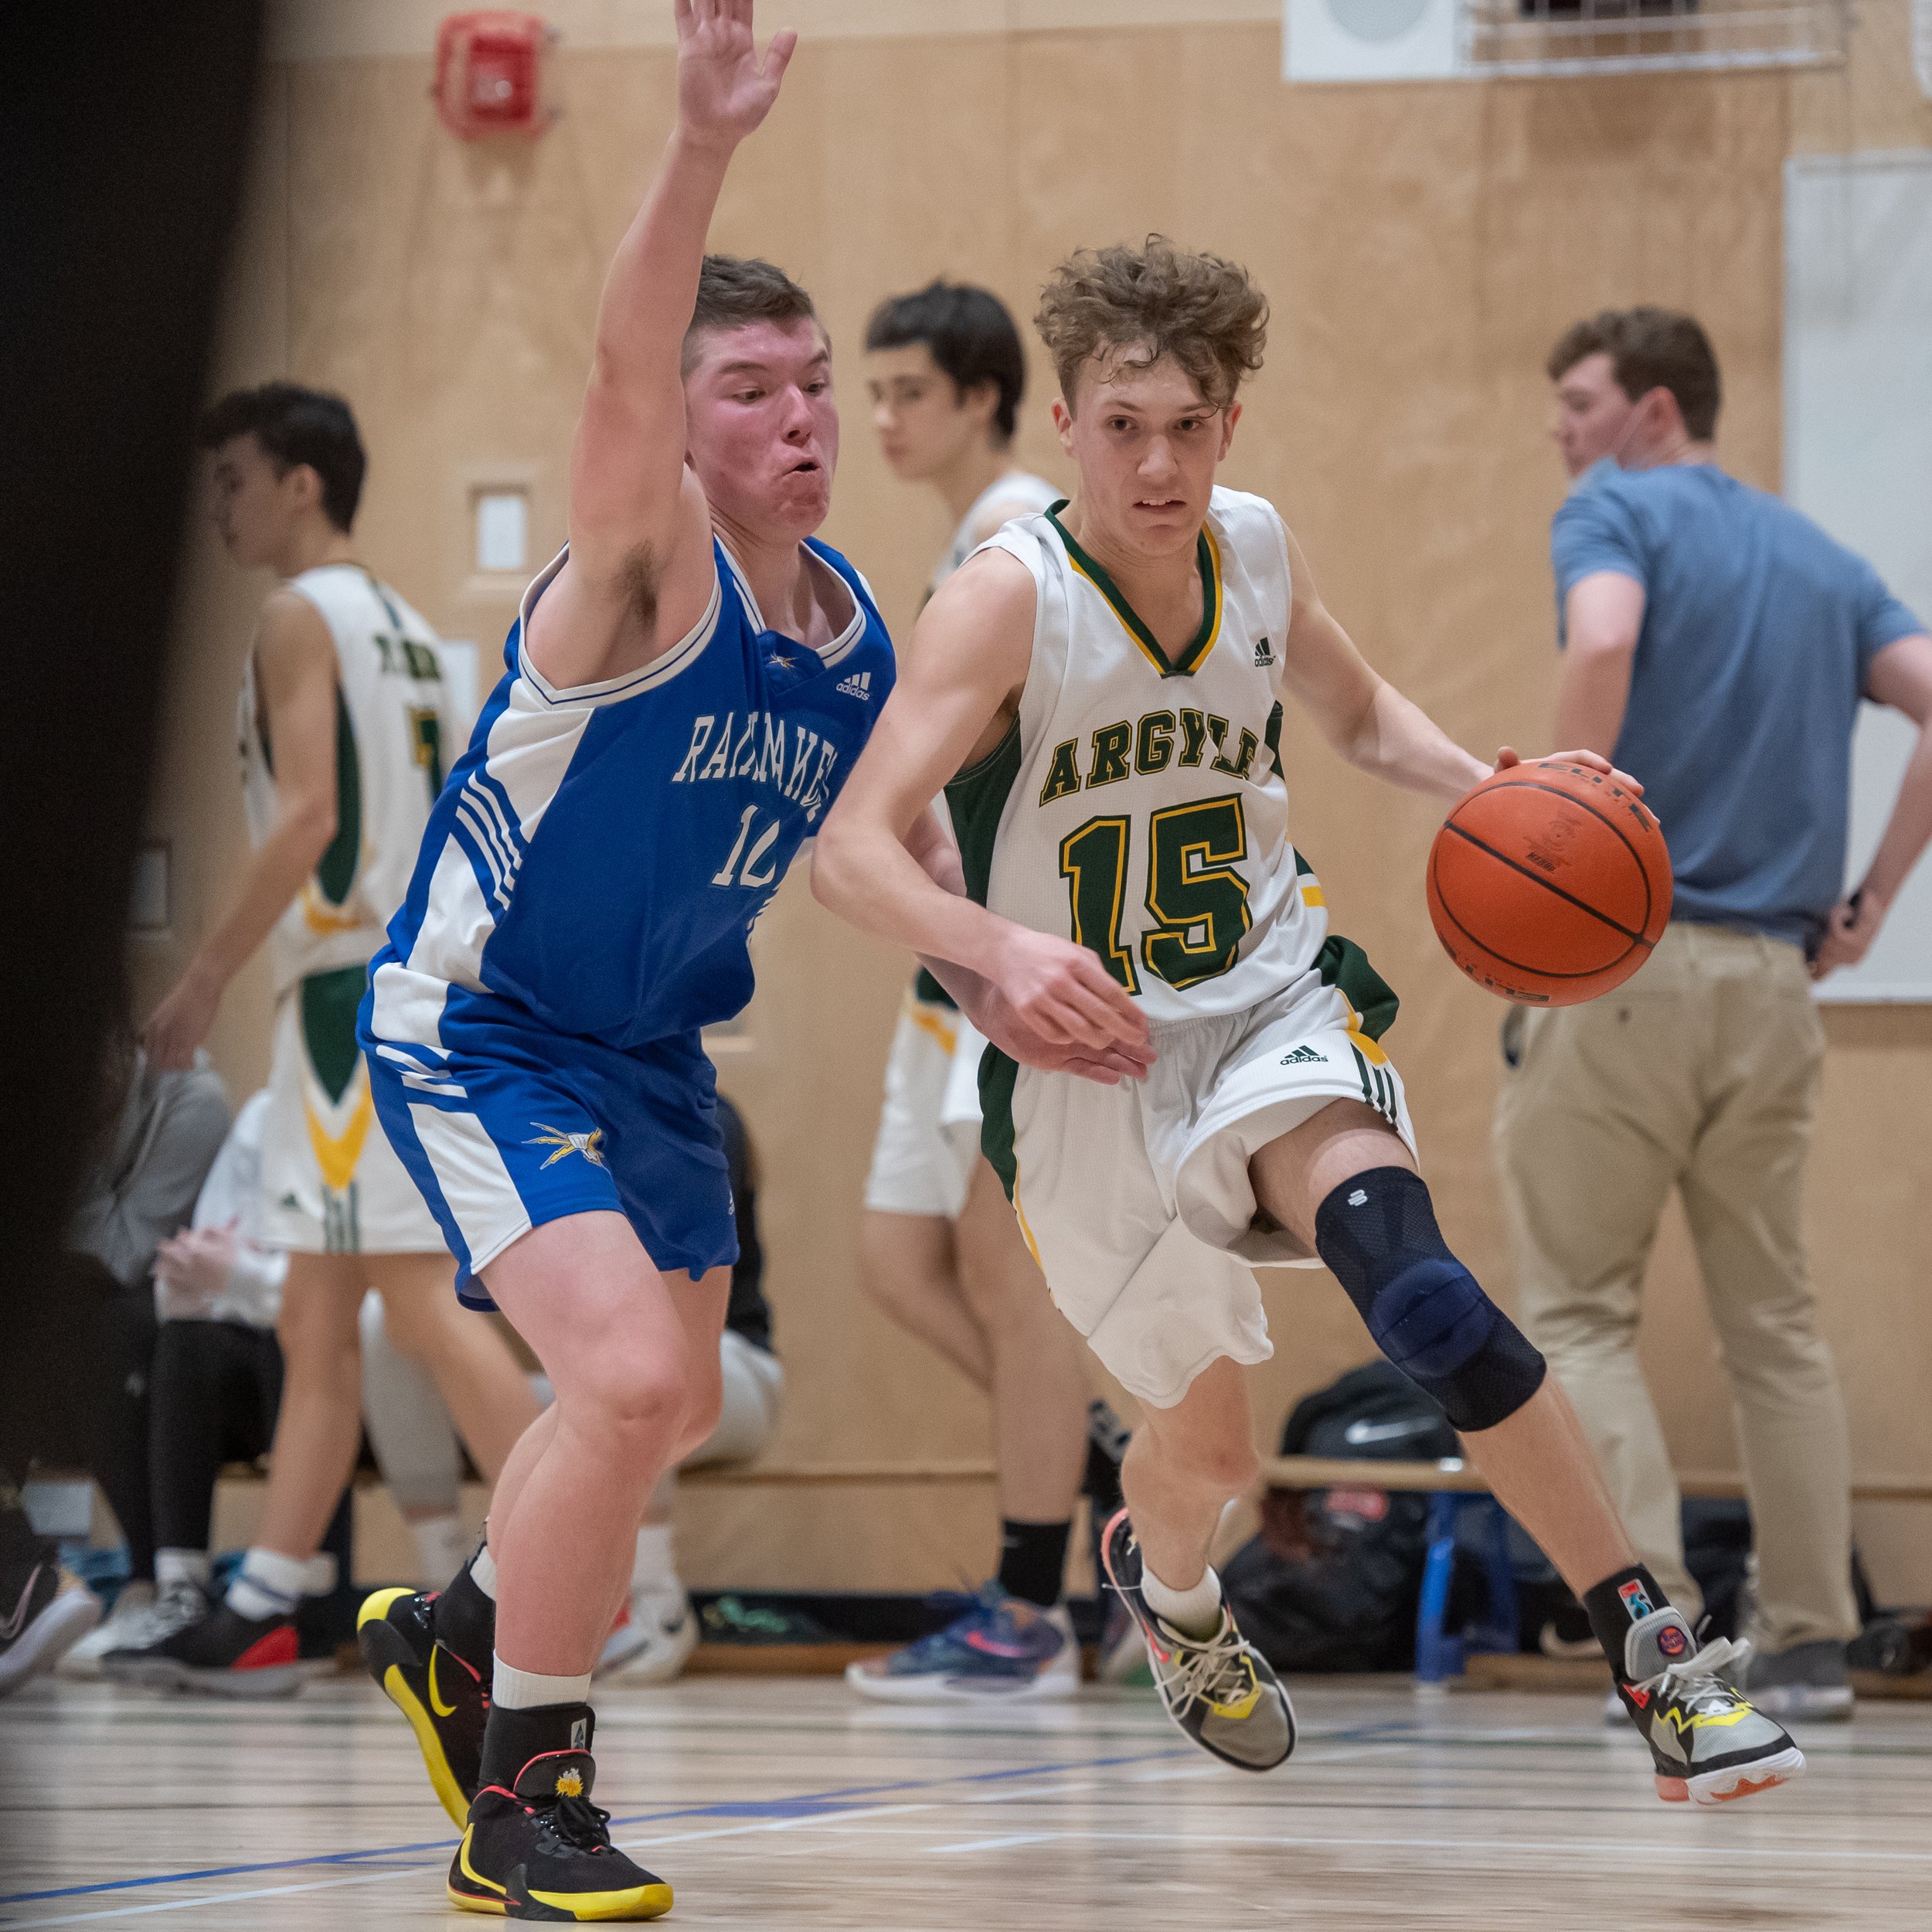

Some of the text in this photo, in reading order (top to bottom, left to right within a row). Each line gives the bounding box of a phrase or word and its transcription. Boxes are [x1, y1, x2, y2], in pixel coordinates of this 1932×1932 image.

[836, 683, 870, 701] adidas
[1039, 708, 1260, 808] ARGYLE
[1059, 792, 1253, 996] 15
[1280, 1055, 1328, 1066] adidas
